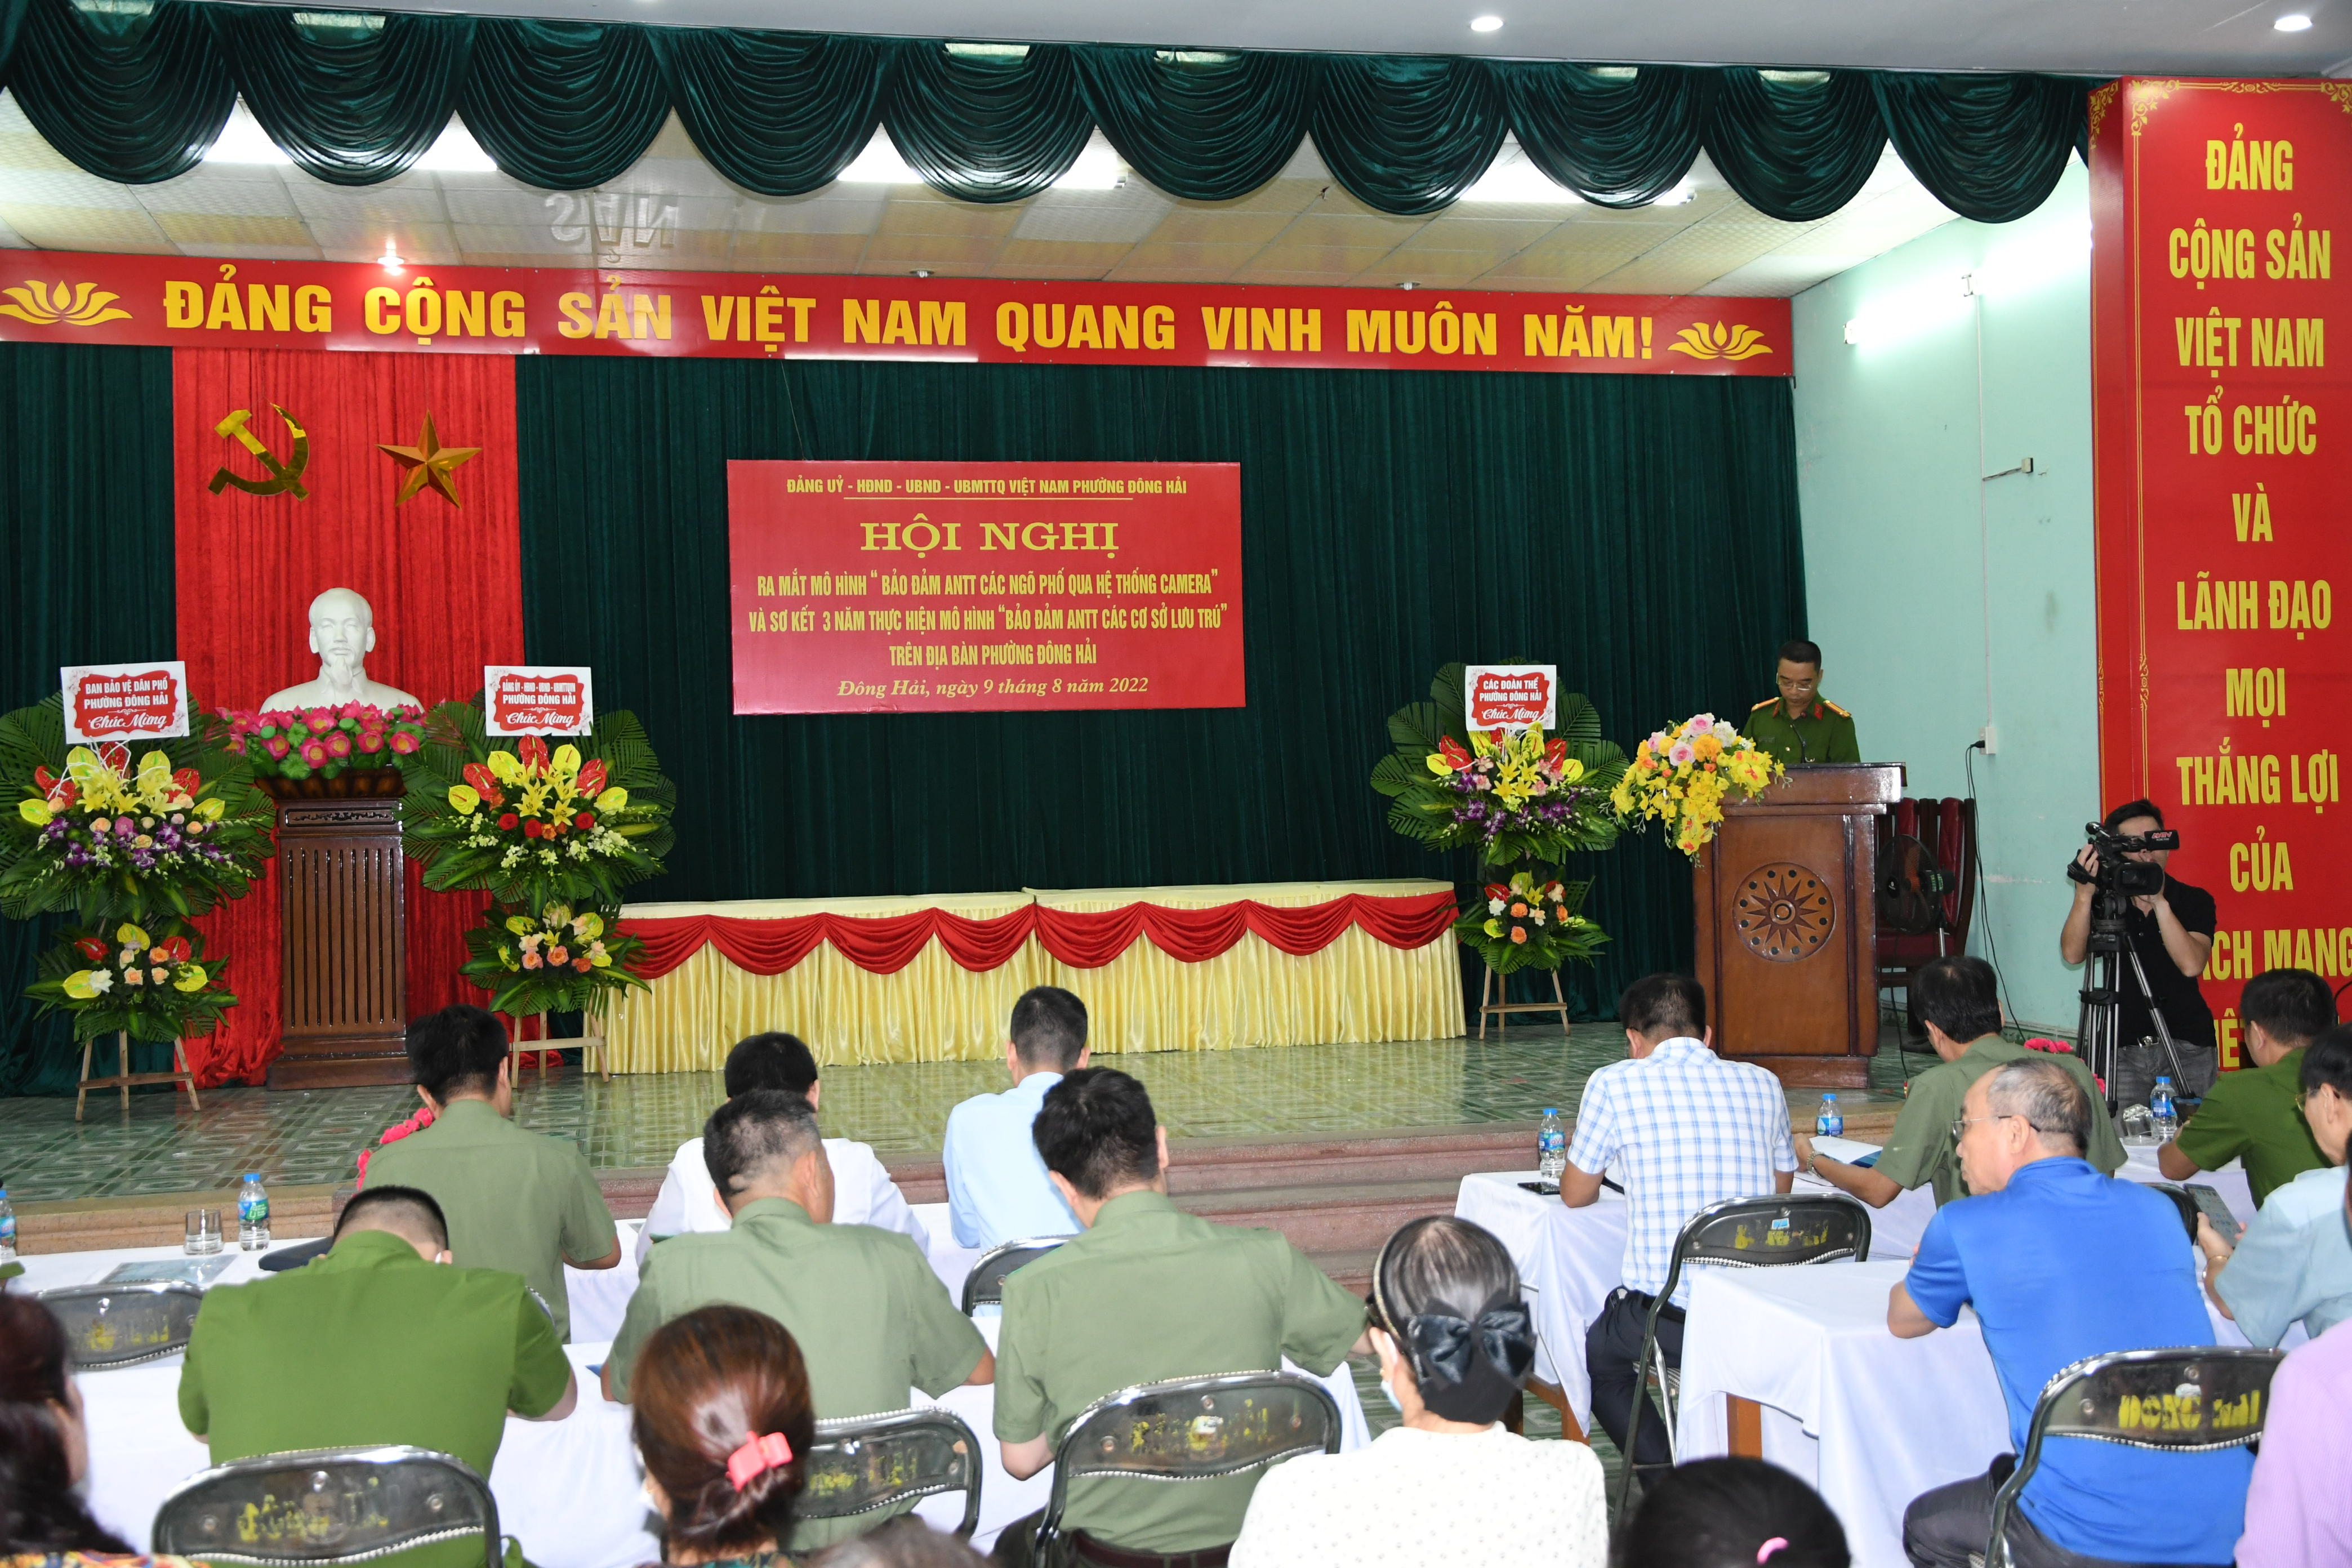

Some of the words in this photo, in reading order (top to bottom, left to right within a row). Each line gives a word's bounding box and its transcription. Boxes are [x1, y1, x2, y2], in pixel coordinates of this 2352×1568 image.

[2206, 123, 2293, 190] ĐẢNG
[2170, 218, 2255, 289] CỘNG
[2266, 213, 2330, 279] SẢN
[163, 264, 331, 332] ĐẢNG
[365, 277, 525, 345] CỘNG
[559, 276, 671, 339] SẢN
[702, 286, 816, 351] VIỆT
[844, 299, 965, 345] NAM
[997, 302, 1174, 351] QUANG
[1202, 307, 1321, 351] VINH
[1347, 301, 1496, 355] MUÔN
[1525, 305, 1652, 359] NĂM!
[2176, 307, 2241, 377] VIỆT
[2252, 318, 2323, 366] NAM
[2185, 385, 2223, 455] TỔ
[2234, 395, 2316, 455] CHỨC
[787, 475, 823, 493] ĐẢNG
[827, 475, 844, 493] UỶ
[857, 479, 892, 493] HĐND
[906, 479, 941, 493] UBND
[954, 480, 1005, 495] UBMTTQ
[1009, 478, 1036, 496] VIỆT
[1040, 480, 1068, 493] NAM
[1073, 477, 1124, 493] PHƯỜNG
[1128, 478, 1162, 493] ĐÔNG
[1166, 476, 1186, 493] HẢI
[2233, 483, 2273, 541] VÀ
[861, 514, 961, 558] HỘI
[981, 523, 1119, 558] NGHỊ
[758, 576, 775, 596] RA
[779, 568, 807, 596] MẮT
[811, 571, 831, 595] MÔ
[836, 571, 866, 595] HÌNH
[882, 568, 907, 595] BẢO
[911, 568, 941, 595] ĐẢM
[945, 575, 976, 595] ANTT
[980, 571, 1005, 595] CÁC
[1009, 571, 1035, 594] NGÕ
[1040, 568, 1064, 594] PHỐ
[1068, 574, 1093, 596] QUA
[1097, 570, 1112, 598] HỆ
[1116, 567, 1156, 594] THỐNG
[2177, 572, 2258, 629] LÃNH
[2269, 580, 2331, 639] ĐẠO
[749, 607, 766, 632] VÀ
[770, 609, 788, 632] SƠ
[791, 605, 815, 631] KẾT
[823, 611, 831, 631] 3
[835, 607, 865, 631] NĂM
[868, 608, 902, 635] THỰC
[906, 606, 936, 635] HIỆN
[939, 606, 960, 630] MÔ
[964, 606, 995, 630] HÌNH
[1035, 603, 1063, 629] ĐẢM
[1067, 609, 1098, 629] ANTT
[1102, 605, 1126, 629] CÁC
[1131, 607, 1147, 629] CƠ
[1151, 602, 1168, 629] SỞ
[1171, 607, 1194, 628] LƯU
[889, 642, 923, 666] TRÊN
[926, 645, 948, 670] ĐỊA
[952, 641, 978, 665] BÀN
[982, 640, 1034, 665] PHƯỜNG
[1037, 640, 1072, 664] ĐÔNG
[1076, 638, 1096, 663] HẢI
[838, 680, 886, 698] Đông
[892, 680, 930, 697] Hải,
[937, 680, 978, 698] ngày
[984, 679, 994, 694] 9
[999, 679, 1048, 697] tháng
[1052, 679, 1062, 693] 8
[1067, 679, 1104, 692] năm
[1109, 678, 1148, 692] 2022
[2226, 667, 2285, 727] MỌI
[2177, 737, 2280, 805] THẮNG
[2291, 750, 2338, 813] LỢI
[2230, 826, 2293, 892] CỦA
